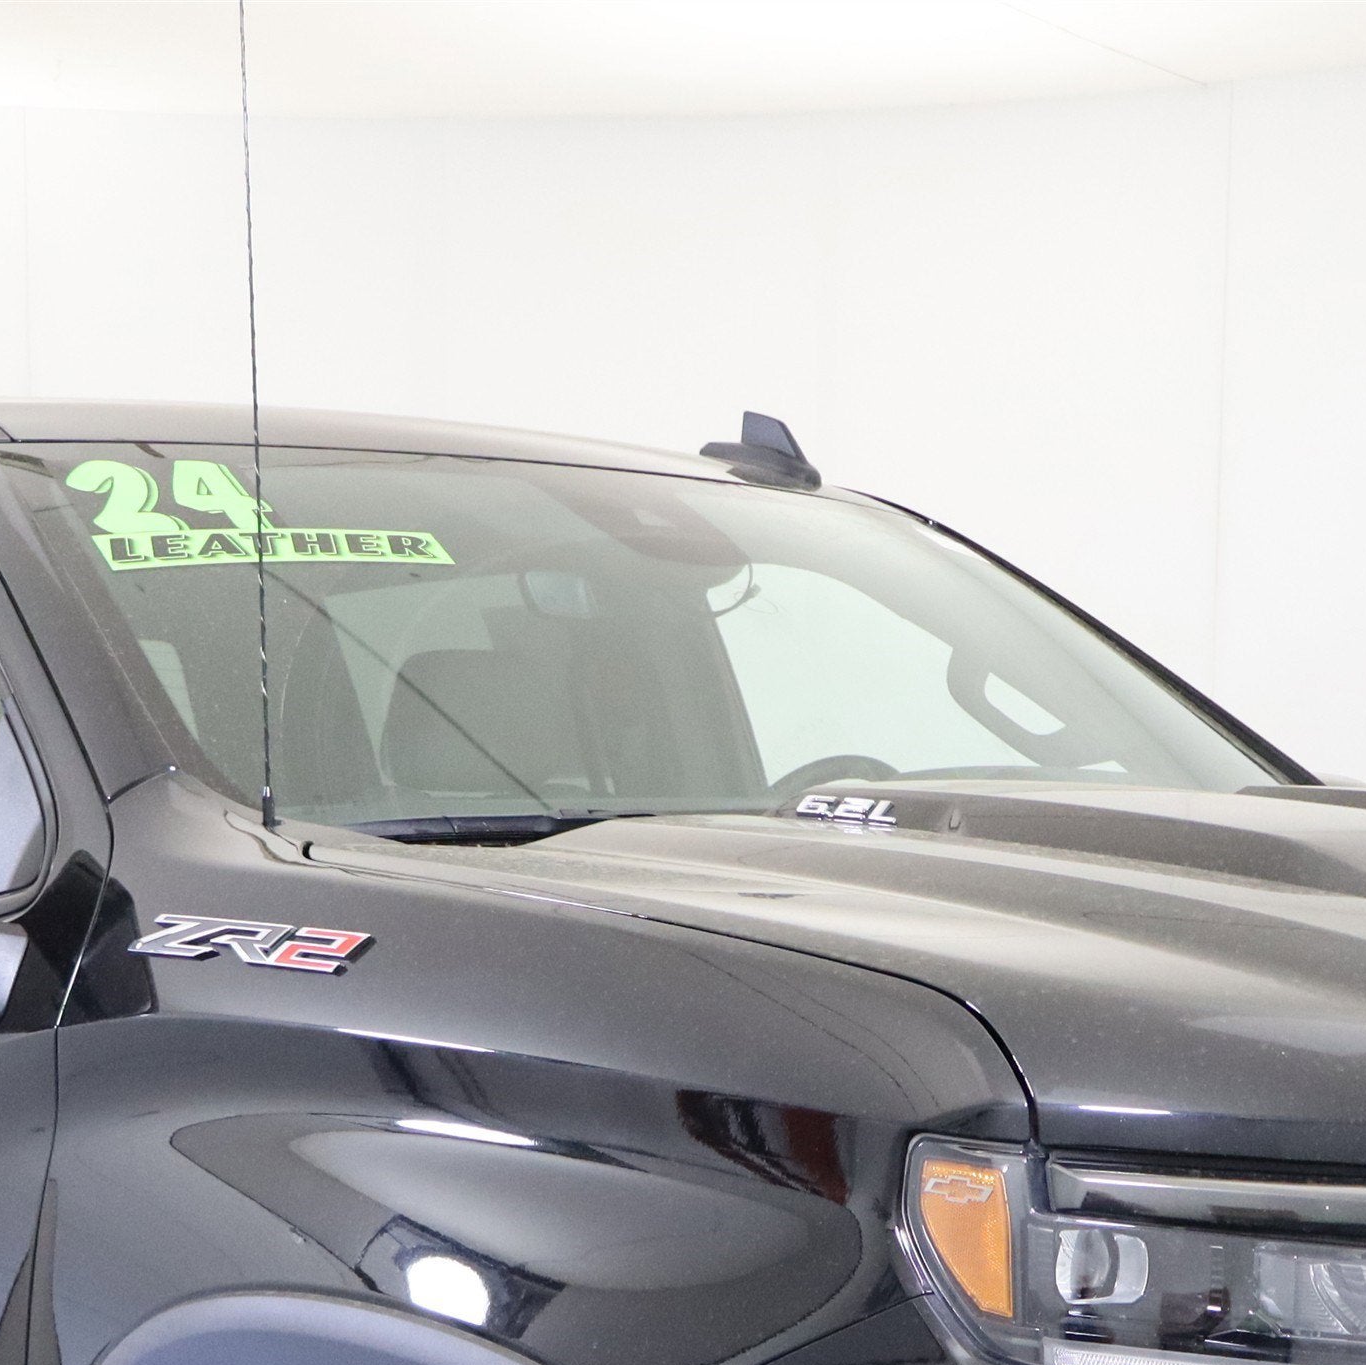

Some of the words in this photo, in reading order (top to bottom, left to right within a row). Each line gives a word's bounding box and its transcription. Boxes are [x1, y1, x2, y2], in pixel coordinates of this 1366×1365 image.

[65, 459, 275, 534] 24
[110, 531, 438, 563] LEATHER
[796, 794, 898, 826] 6.2L
[127, 913, 373, 974] ZR2
